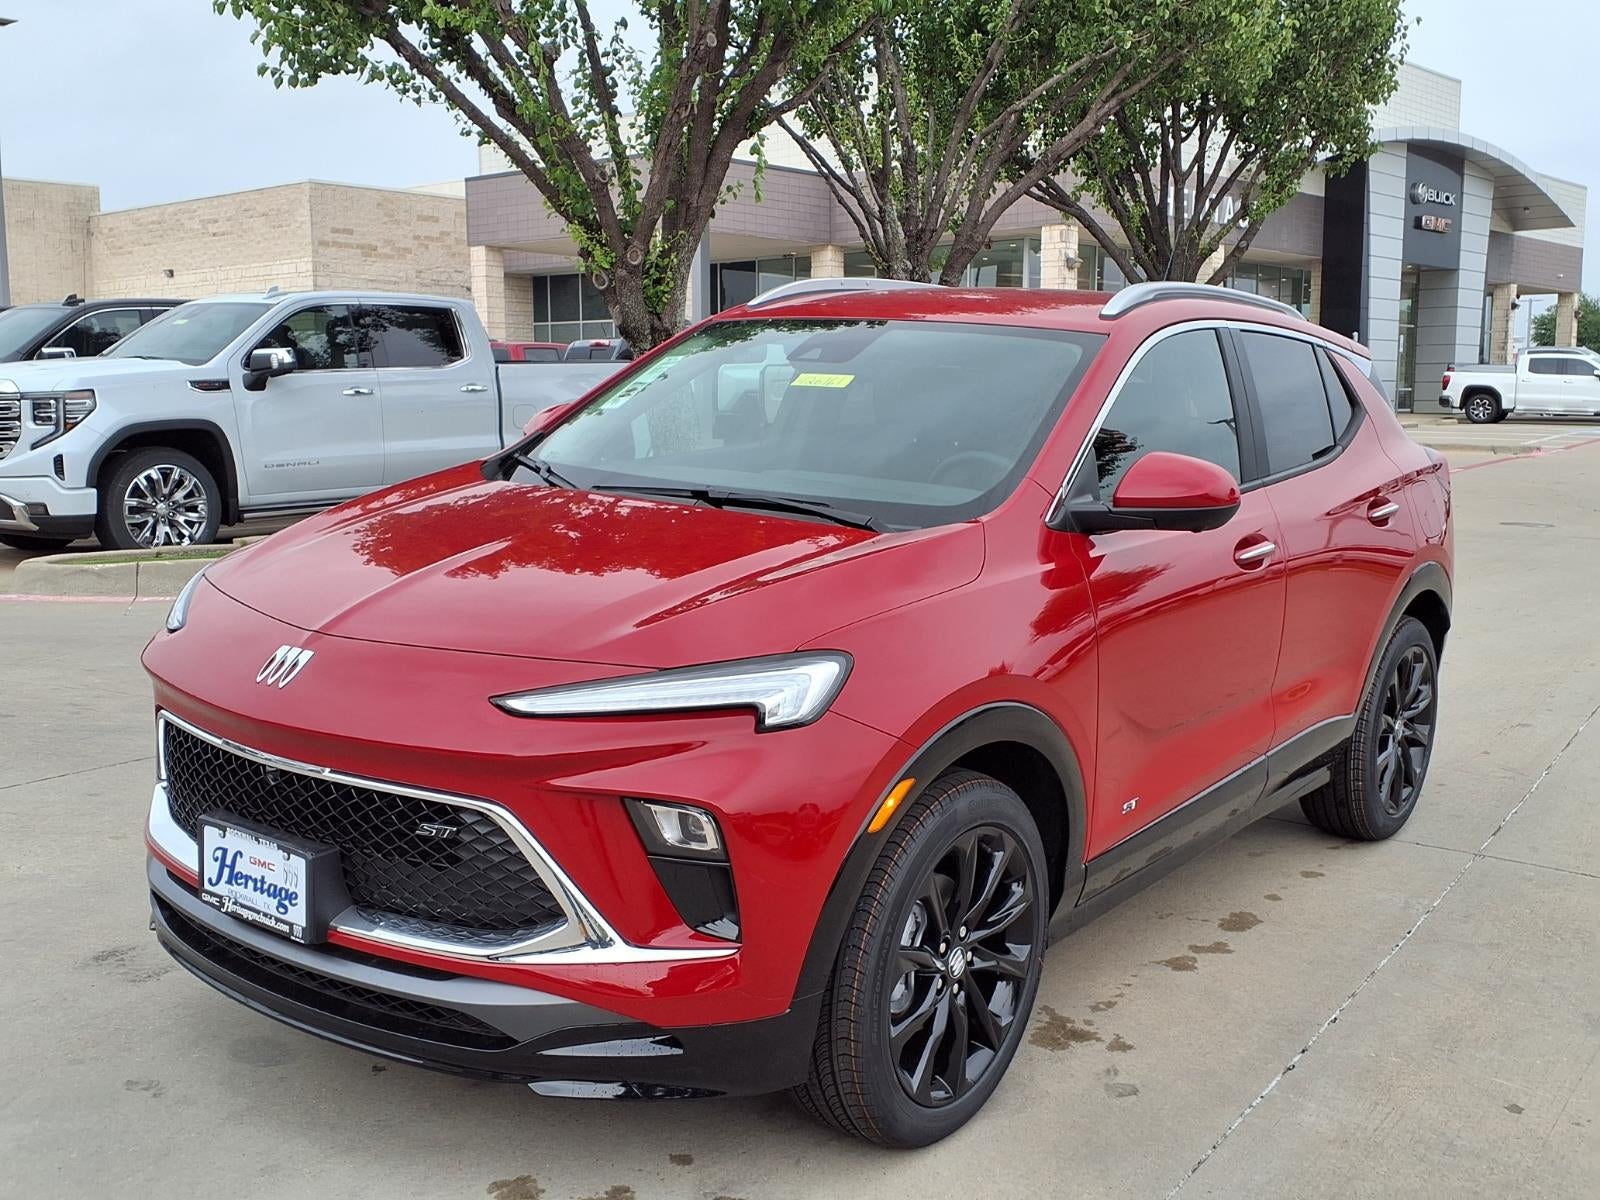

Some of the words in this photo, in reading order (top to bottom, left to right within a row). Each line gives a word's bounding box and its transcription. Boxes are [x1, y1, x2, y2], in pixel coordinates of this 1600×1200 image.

[1427, 188, 1456, 206] BUICK
[1421, 214, 1452, 233] GMC
[415, 823, 457, 838] ST
[249, 855, 276, 872] GMC
[207, 846, 299, 915] Heritage
[201, 892, 220, 906] GMC
